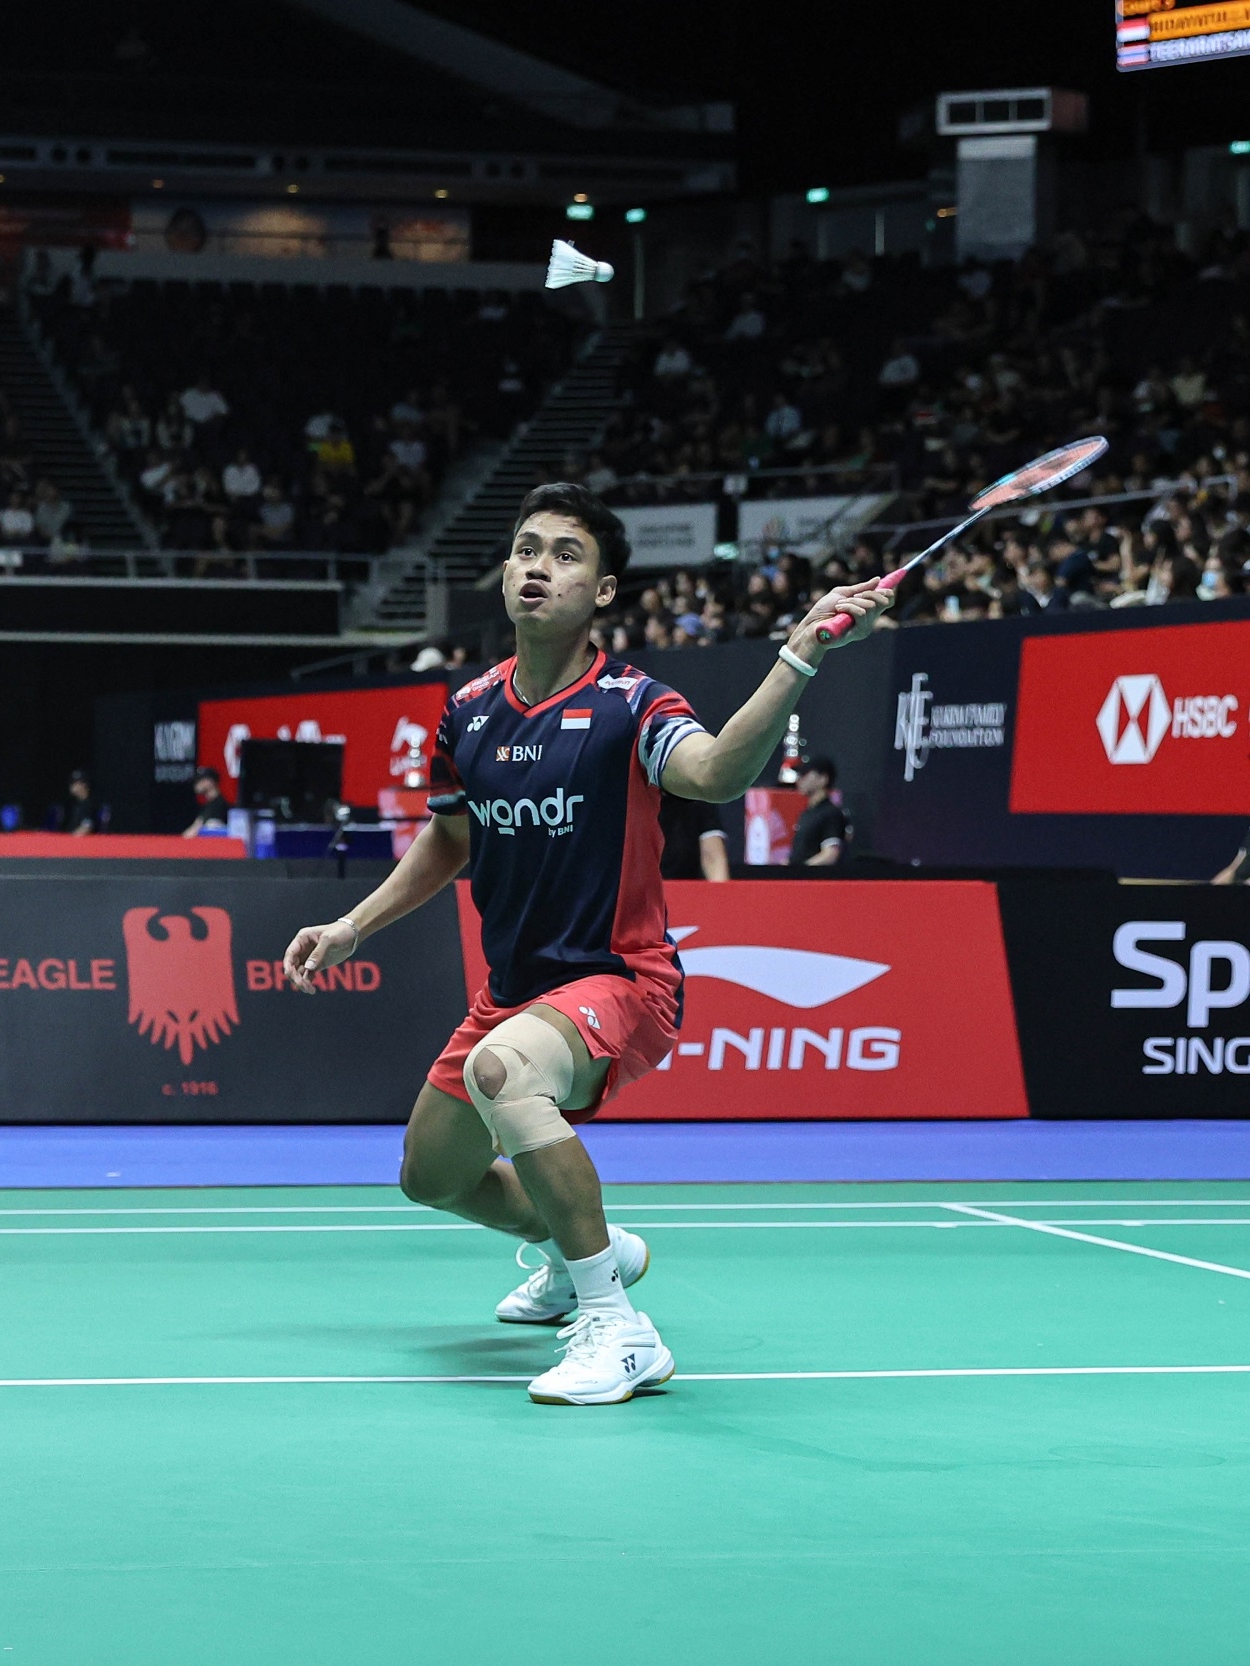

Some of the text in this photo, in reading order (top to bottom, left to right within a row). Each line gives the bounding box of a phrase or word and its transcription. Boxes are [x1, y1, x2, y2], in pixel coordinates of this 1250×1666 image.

[1171, 694, 1239, 739] HSBC
[512, 745, 543, 761] BNI
[557, 824, 574, 836] BNI
[1110, 920, 1250, 1029] Sp
[1141, 1036, 1250, 1075] SING
